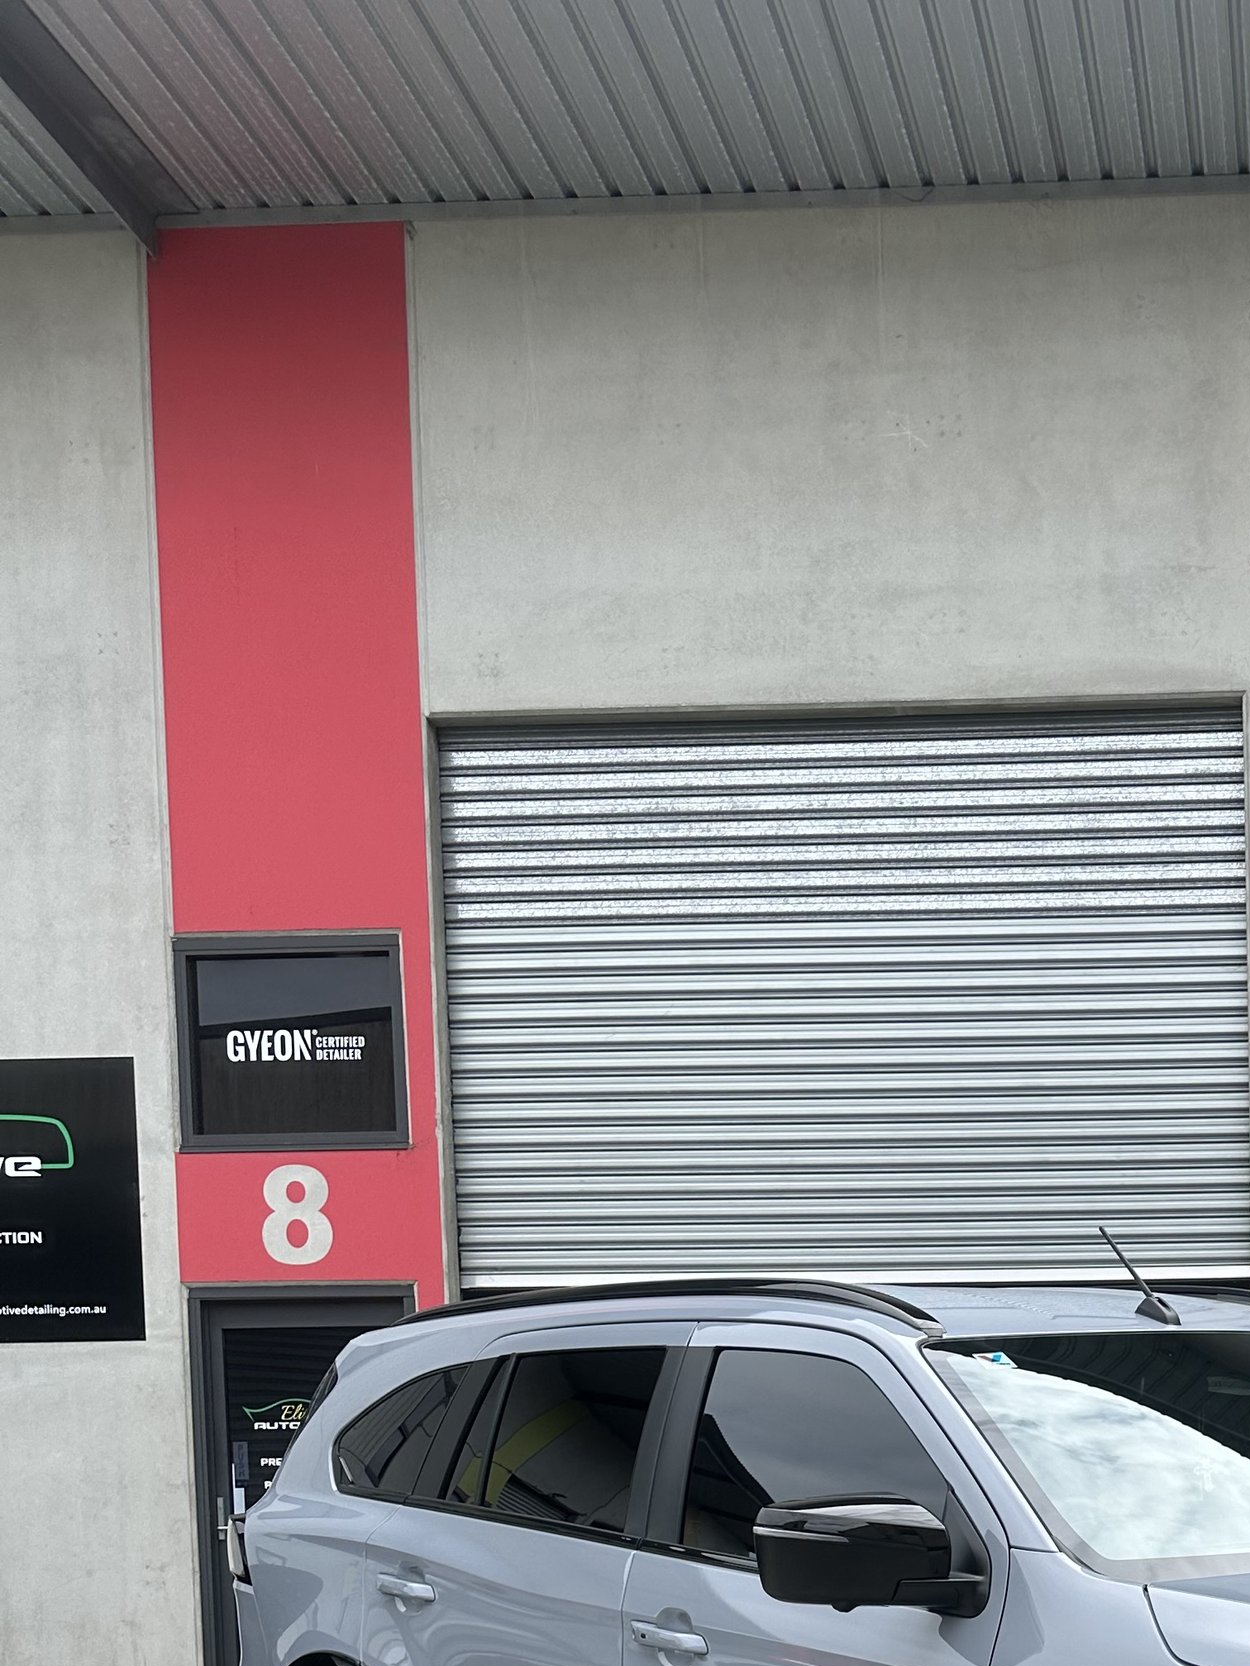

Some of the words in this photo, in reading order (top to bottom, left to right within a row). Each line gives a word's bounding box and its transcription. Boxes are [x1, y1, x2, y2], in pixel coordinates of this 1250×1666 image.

[315, 1036, 366, 1048] CERTIFIED
[316, 1049, 362, 1061] DETAILER
[0, 1156, 42, 1177] e
[262, 1164, 333, 1266] 8
